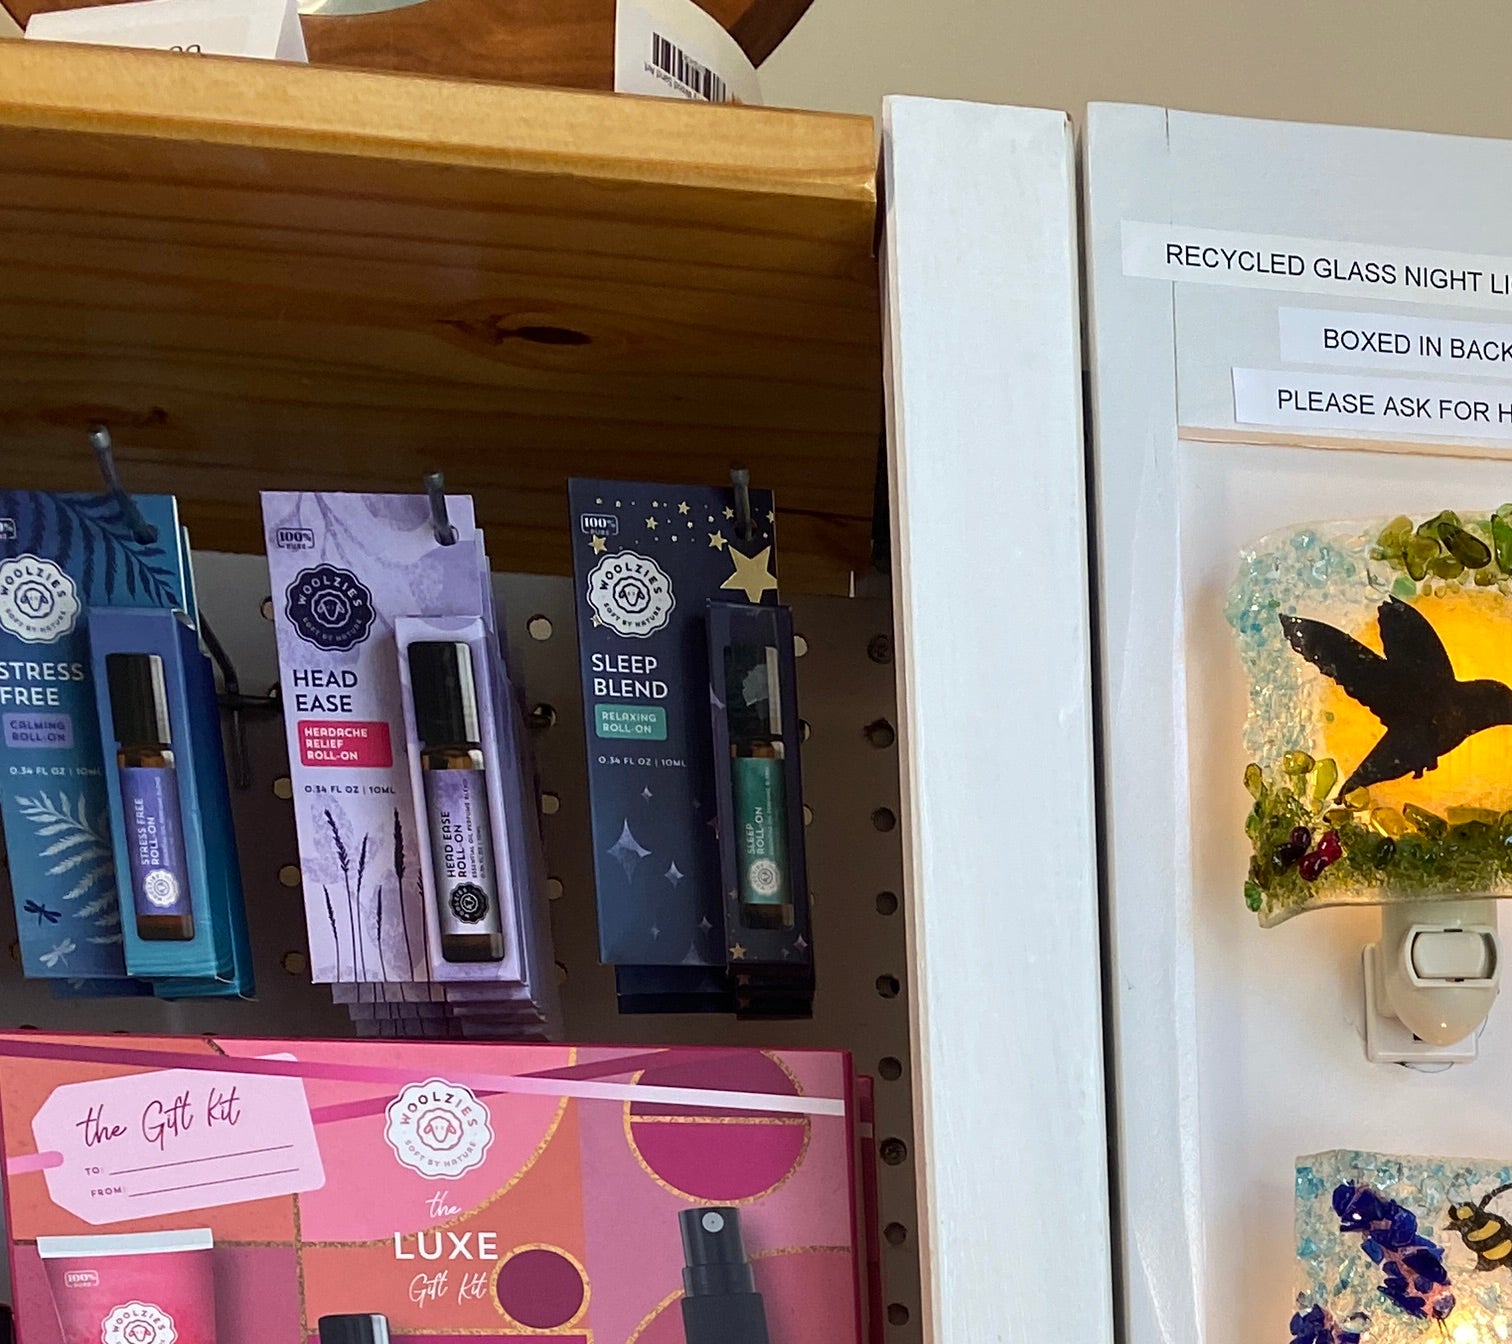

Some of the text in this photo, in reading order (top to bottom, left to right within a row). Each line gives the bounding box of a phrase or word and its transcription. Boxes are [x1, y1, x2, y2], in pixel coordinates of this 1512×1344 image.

[1166, 243, 1304, 276] RECYCLED
[1313, 258, 1397, 286] GLASS
[1405, 265, 1481, 293] NIGHT
[1323, 327, 1411, 356] BOXED
[1419, 336, 1442, 358] IN
[1277, 388, 1375, 416] PLEASE
[1383, 395, 1432, 419] ASK
[1439, 399, 1491, 423] FOR
[0, 566, 66, 598] WOOLZIES
[298, 576, 363, 607] WOOLZIES
[600, 562, 662, 594] WOOLZIES
[0, 662, 84, 681] STRESS
[591, 653, 658, 674] SLEEP
[293, 669, 359, 688] HEAD
[594, 678, 668, 699] BLEND
[1, 687, 60, 706] FREE
[295, 694, 353, 712] EASE
[10, 720, 66, 731] CALMING
[601, 711, 657, 723] RELAXING
[304, 727, 368, 738] HEADACHE
[305, 738, 344, 749] RELIEF
[306, 751, 359, 761] ROLL-ON
[623, 757, 687, 768] FL OZ 10ML
[330, 785, 342, 794] FL
[345, 785, 360, 794] OZ
[368, 785, 396, 795] 10ML
[134, 798, 151, 866] STRESS FREE
[147, 817, 160, 866] ROLL-ON
[440, 811, 456, 878] HEAD EASE
[745, 823, 756, 855] SLEEP
[453, 824, 467, 878] ROLL-ON
[76, 1085, 241, 1151] the Gift Kit
[400, 1091, 478, 1127] WOOLZIES
[404, 1139, 477, 1168] SOFT BY NATURE
[84, 1166, 104, 1176] TO:
[90, 1186, 126, 1199] FROM:
[425, 1191, 462, 1218] the
[393, 1231, 499, 1261] LUXE
[408, 1269, 488, 1309] Gift Kit
[112, 1309, 166, 1333] WOOLZIES
